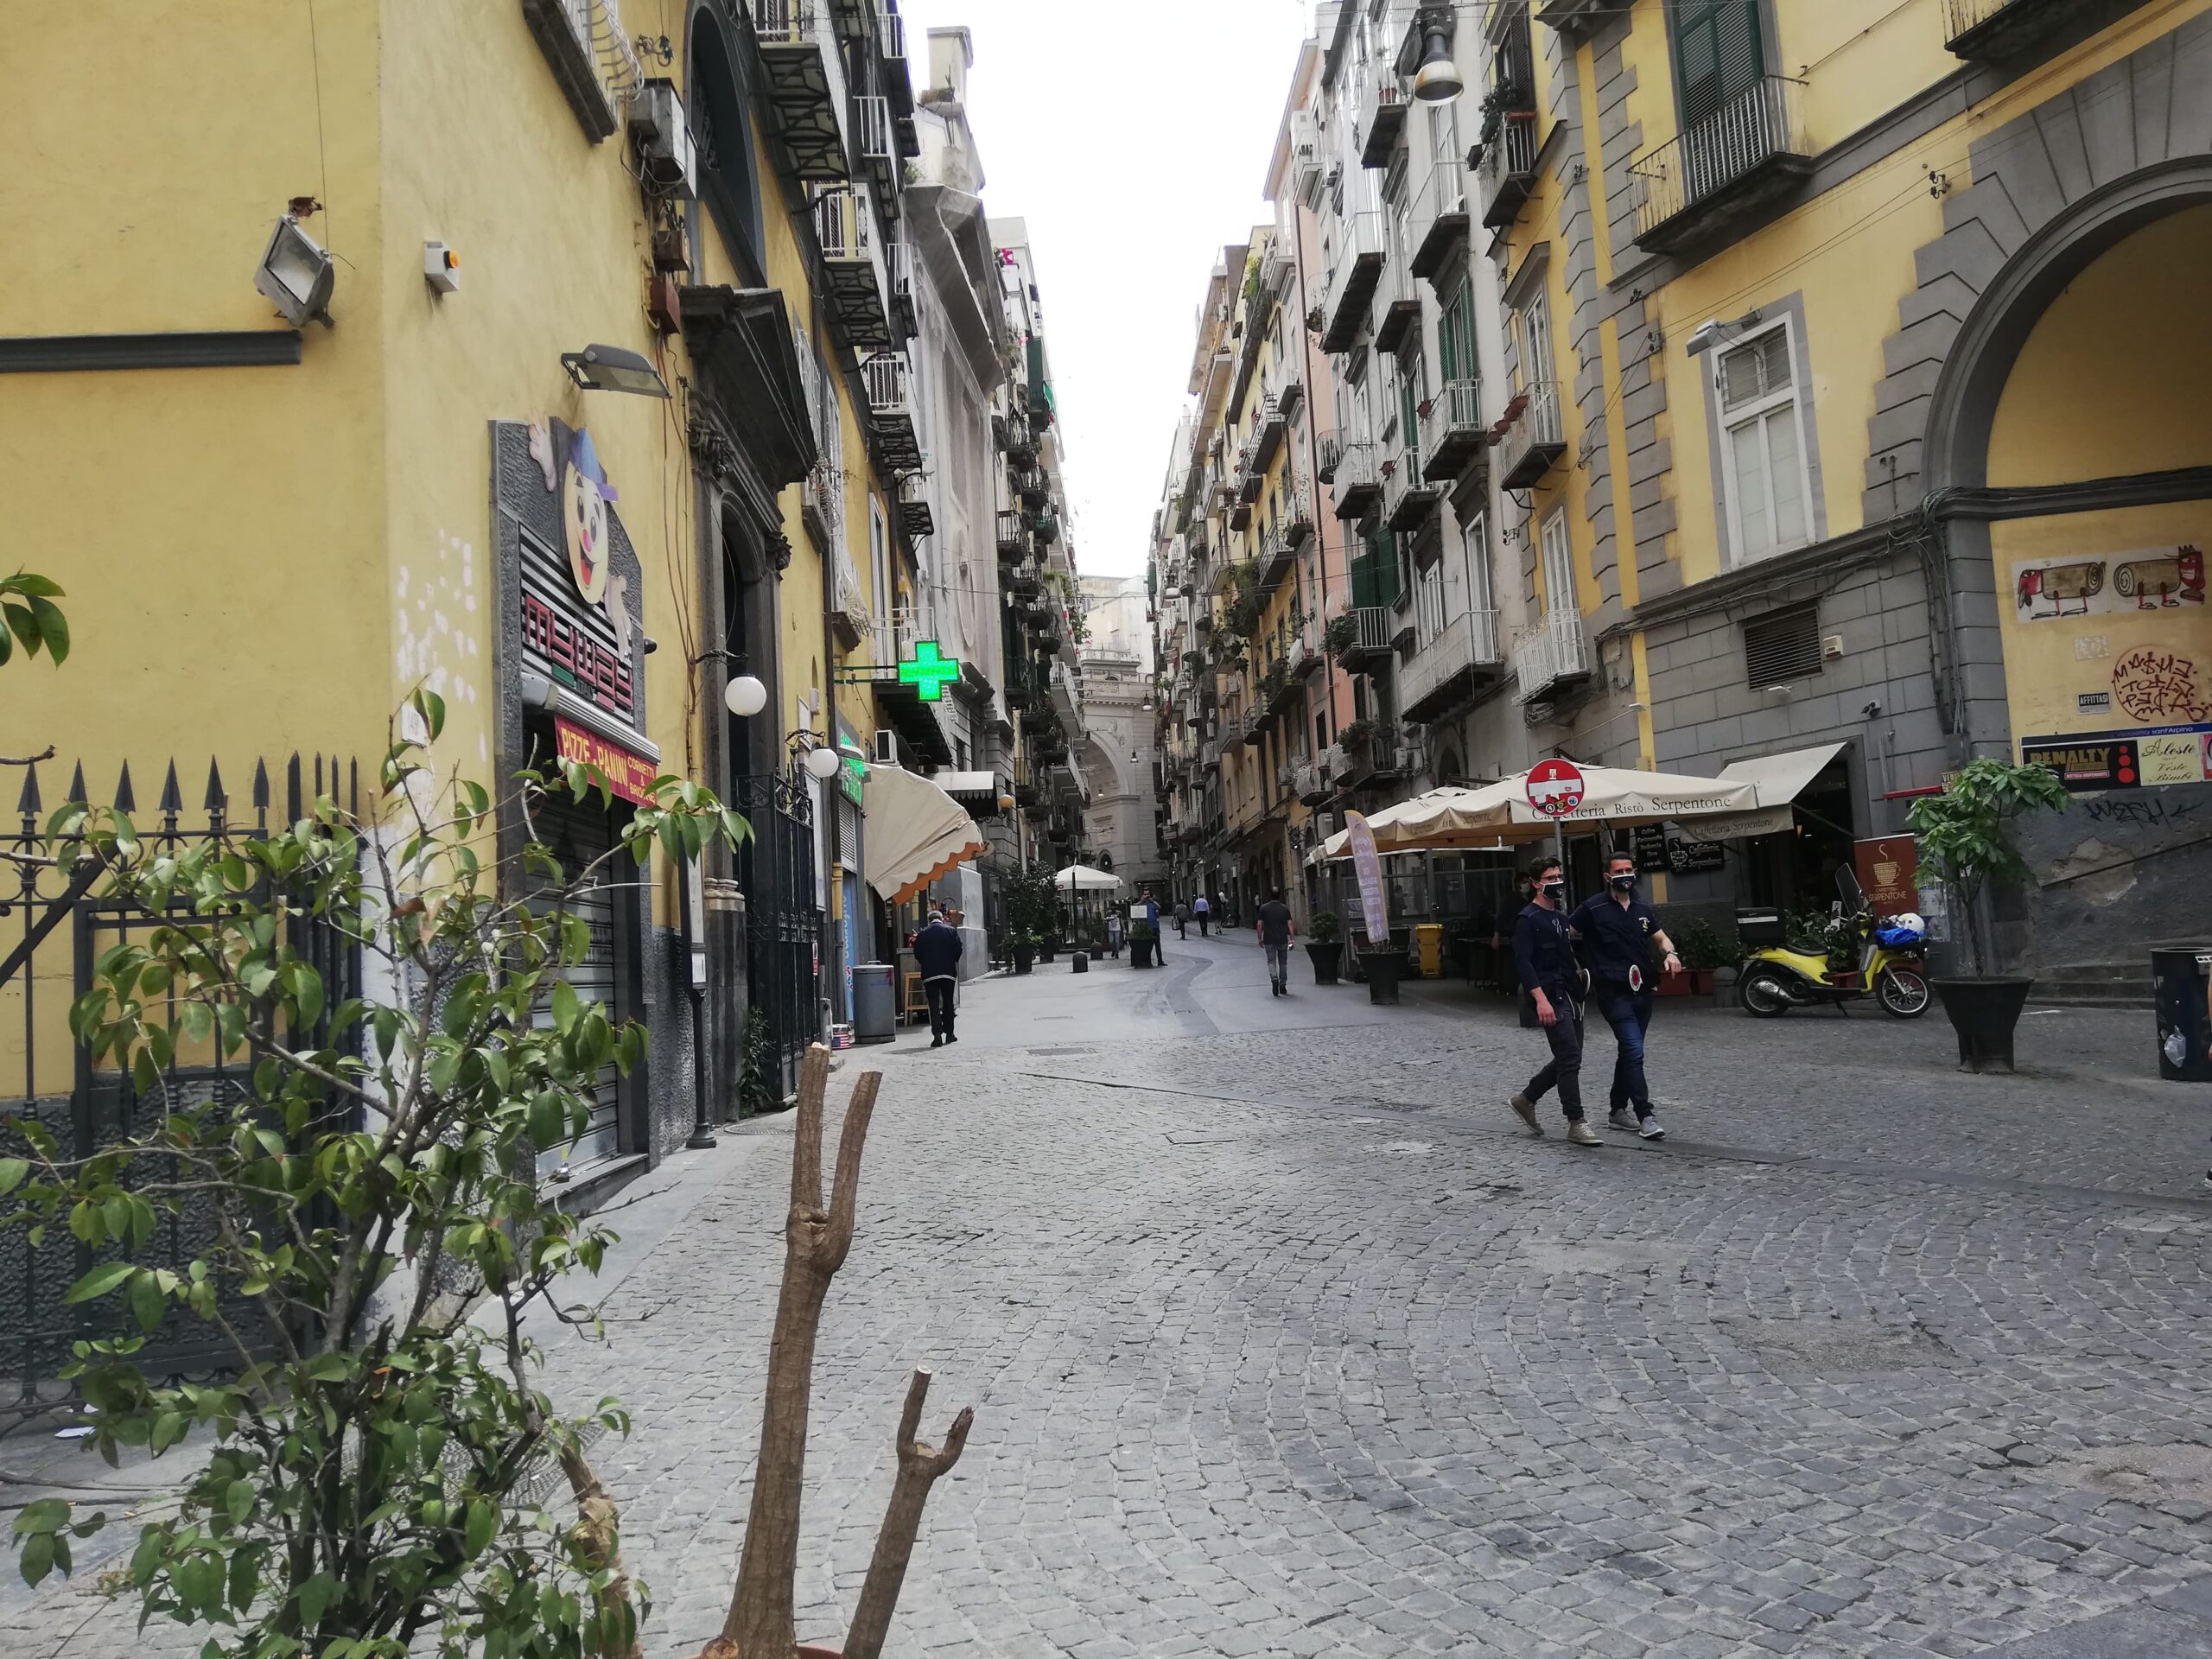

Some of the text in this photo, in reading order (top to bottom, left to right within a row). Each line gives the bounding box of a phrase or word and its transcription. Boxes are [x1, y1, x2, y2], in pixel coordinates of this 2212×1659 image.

[2080, 694, 2108, 705] AFFITTASI
[2152, 726, 2194, 735] sant'Arpino
[561, 727, 628, 787] PIZZE PANINI
[2030, 747, 2111, 766] PENALTY
[627, 755, 655, 779] CORNETTI
[1532, 797, 1732, 821] Caetteria Ristò Serpentone
[1694, 818, 1774, 838] Caffetteria Serpentone
[1868, 891, 1908, 902] SERPENTONE
